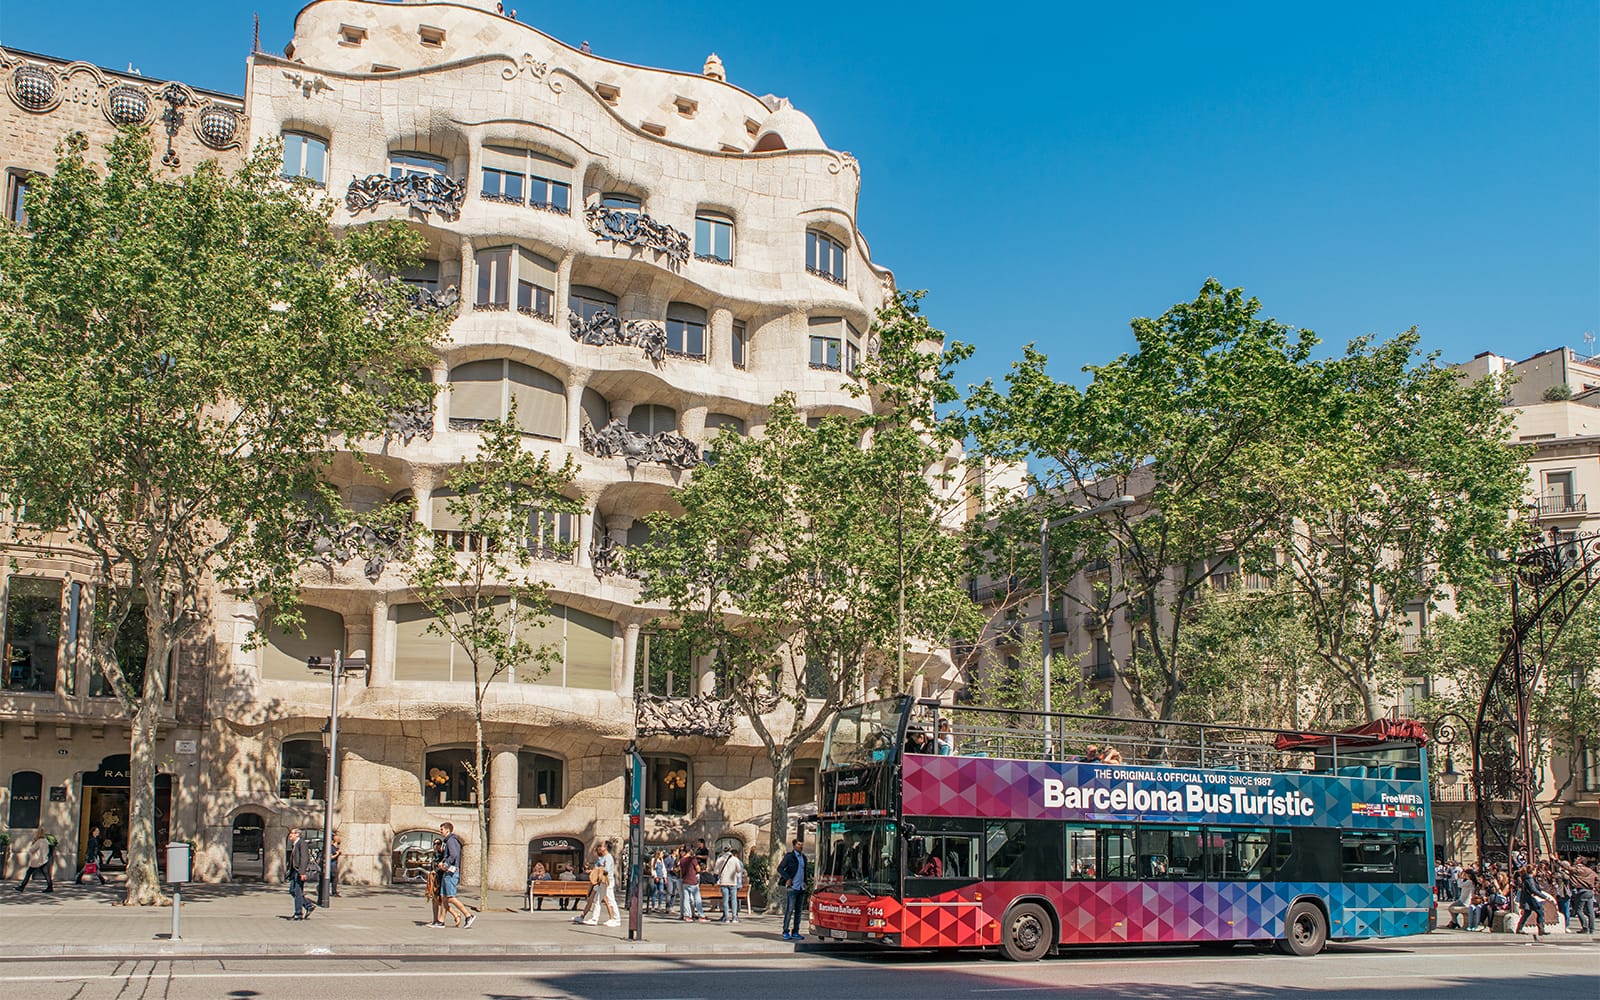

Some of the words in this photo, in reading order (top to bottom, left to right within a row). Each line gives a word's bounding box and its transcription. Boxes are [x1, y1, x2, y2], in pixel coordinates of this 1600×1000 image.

[64, 86, 99, 108] 1898
[104, 770, 131, 778] RAB
[1094, 769, 1112, 779] THE
[1113, 770, 1156, 781] ORIGINAL
[1156, 773, 1163, 781] &
[1163, 772, 1203, 783] OFFICIAL
[1204, 775, 1227, 784] TOUR
[1229, 776, 1253, 786] SINCE
[1254, 777, 1272, 787] 1987
[1043, 778, 1183, 813] Barcelona
[1186, 784, 1315, 817] BusTurístic
[866, 907, 884, 917] 2144
